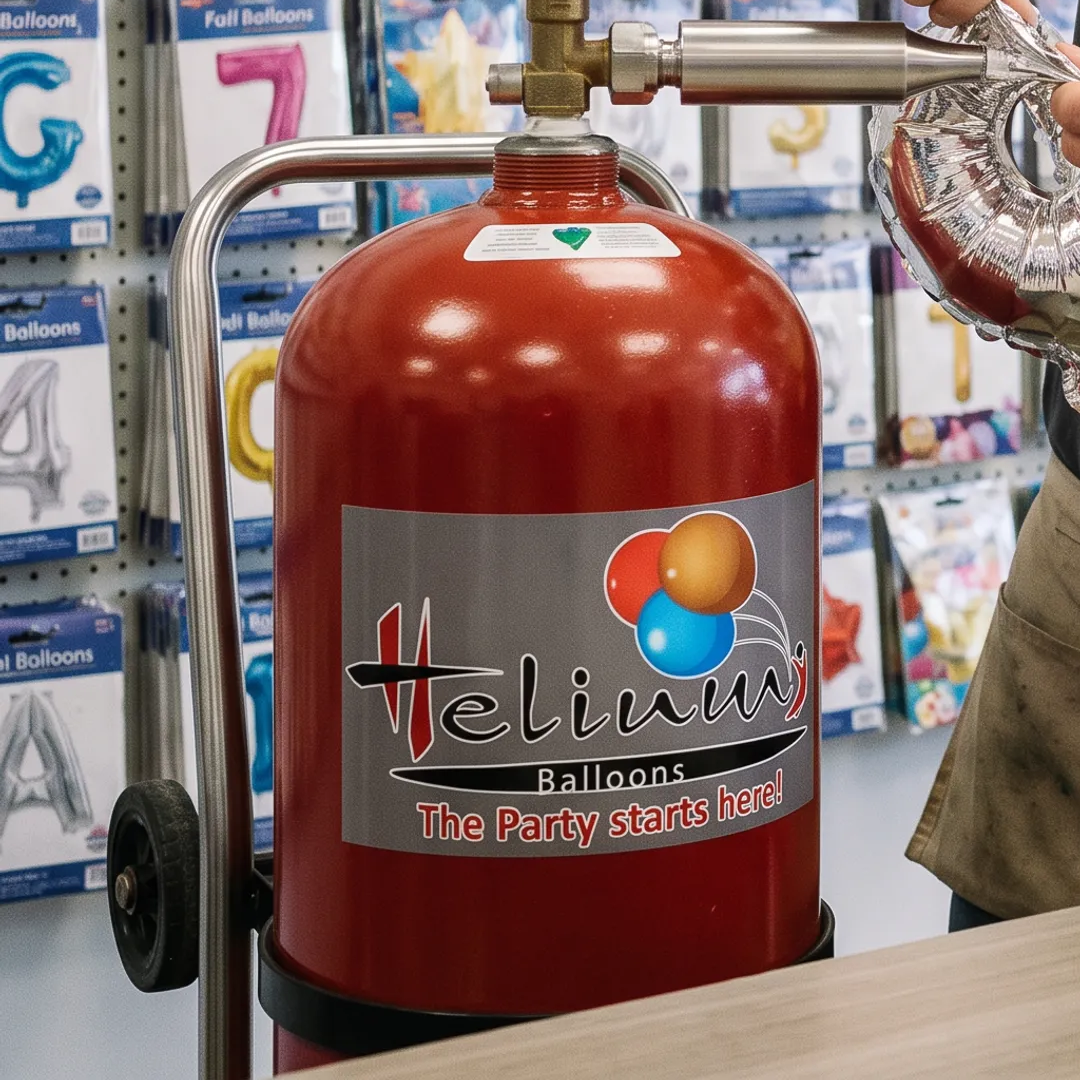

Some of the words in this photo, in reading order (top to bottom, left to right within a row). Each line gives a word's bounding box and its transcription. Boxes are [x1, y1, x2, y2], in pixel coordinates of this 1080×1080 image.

[5, 320, 81, 342] Balloons
[537, 763, 686, 794] Balloons
[417, 802, 485, 842] The
[496, 806, 600, 848] Party
[608, 796, 709, 839] starts
[717, 769, 784, 822] here!
